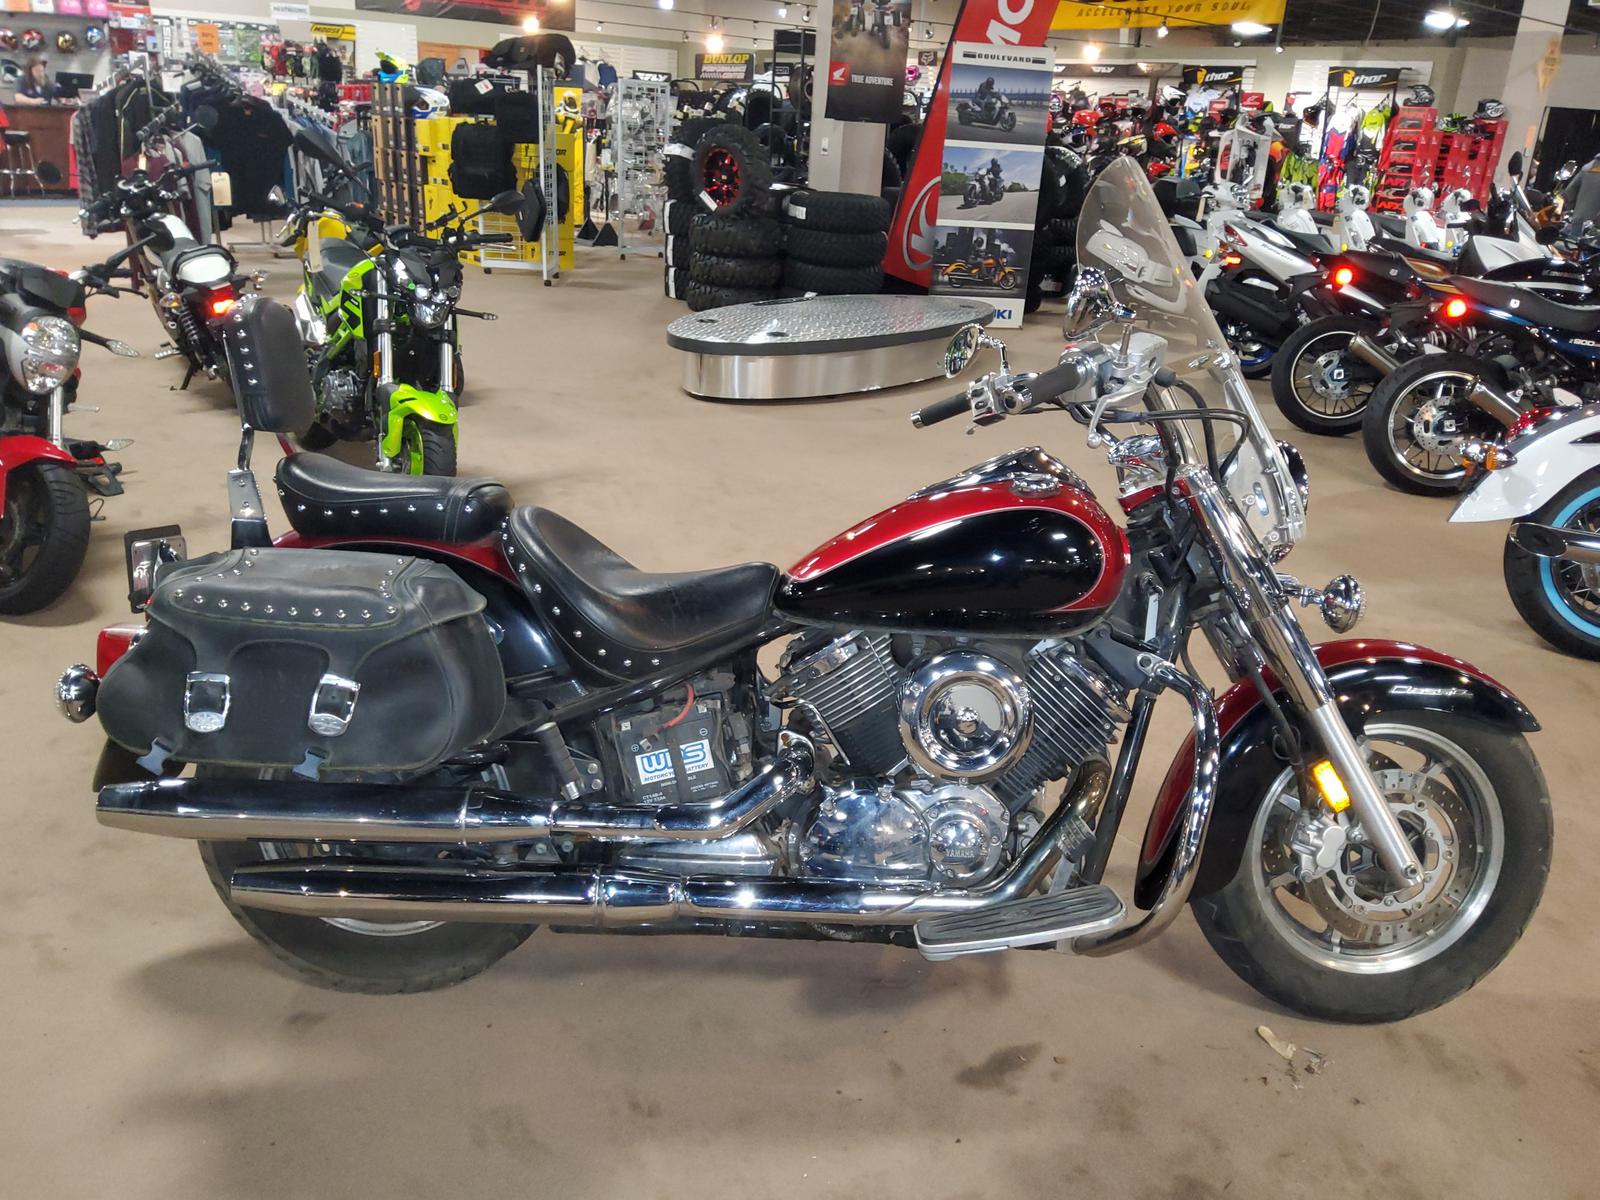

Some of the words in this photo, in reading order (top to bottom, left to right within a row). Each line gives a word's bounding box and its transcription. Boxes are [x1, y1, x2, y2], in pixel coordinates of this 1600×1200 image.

[1077, 5, 1158, 17] ACCELEATE
[1167, 4, 1201, 12] YOUR
[703, 54, 750, 64] DUNLOP
[977, 52, 1031, 63] BOULEVARD
[851, 74, 864, 84] TRUE
[865, 75, 894, 86] ADVENTURE
[1205, 71, 1234, 82] thor
[1352, 74, 1387, 85] thor
[640, 742, 706, 774] WS
[644, 771, 675, 781] MOTORCY
[685, 762, 709, 773] ATTERY
[945, 848, 975, 858] YAMAHA
